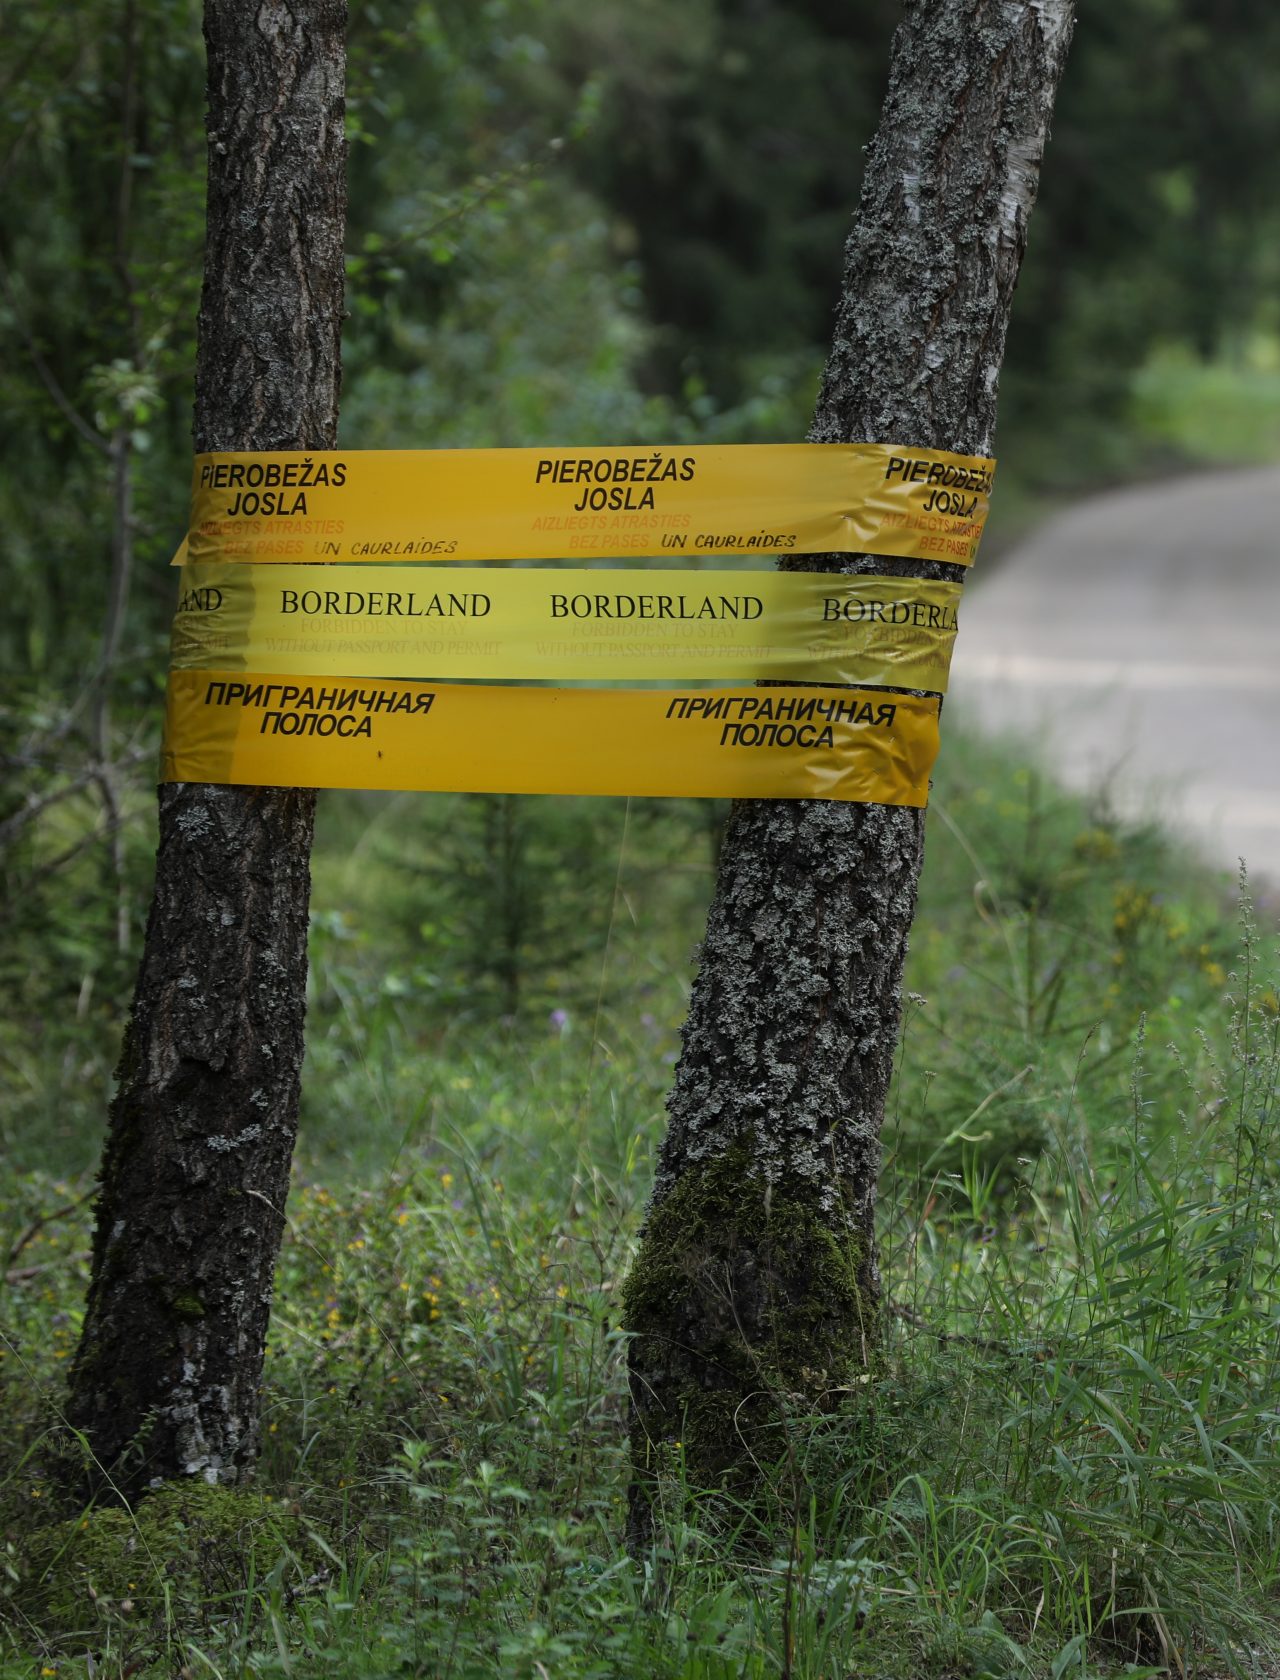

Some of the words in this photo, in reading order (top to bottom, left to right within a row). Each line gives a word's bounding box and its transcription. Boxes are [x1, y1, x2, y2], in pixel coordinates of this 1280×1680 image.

[200, 458, 347, 488] PIEROBEŽAS
[535, 452, 696, 483] PIEROBEŽAS
[227, 492, 308, 516] JOSLA
[574, 486, 656, 511] JOSLA
[923, 489, 978, 518] JOSLA
[264, 519, 345, 535] ATRASTIES
[531, 515, 607, 531] AIZLIEGTS
[611, 514, 692, 530] ATRASTIES
[881, 512, 950, 533] AIZLIEGTS
[255, 539, 304, 554] PASES
[314, 540, 341, 556] UN
[568, 534, 598, 549] BEZ
[602, 534, 650, 549] PASES
[660, 533, 688, 549] UN
[919, 536, 945, 552] BEZ
[946, 540, 969, 557] PASES
[280, 590, 492, 617] BORDERLAND
[550, 593, 764, 621] BORDERLAND
[300, 618, 397, 634] FORBIDDEN
[402, 619, 423, 634] TO
[427, 619, 467, 636] STAY
[571, 622, 667, 638] FORBIDDEN
[672, 622, 695, 638] TO
[697, 622, 739, 639] STAY
[264, 637, 336, 653] WITHOUT
[337, 638, 409, 655] PASSPORT
[412, 640, 444, 656] AND
[447, 641, 502, 656] PERMIT
[535, 640, 608, 656] WITHOUT
[608, 641, 681, 657] PASSPORT
[681, 643, 714, 658] AND
[204, 682, 436, 714] ПРИГРАНИЧНАЯ
[665, 697, 897, 728] ПРИГРАНИЧНАЯ
[259, 711, 372, 738] ПОЛОСА
[719, 722, 834, 749] ПОЛОСА
